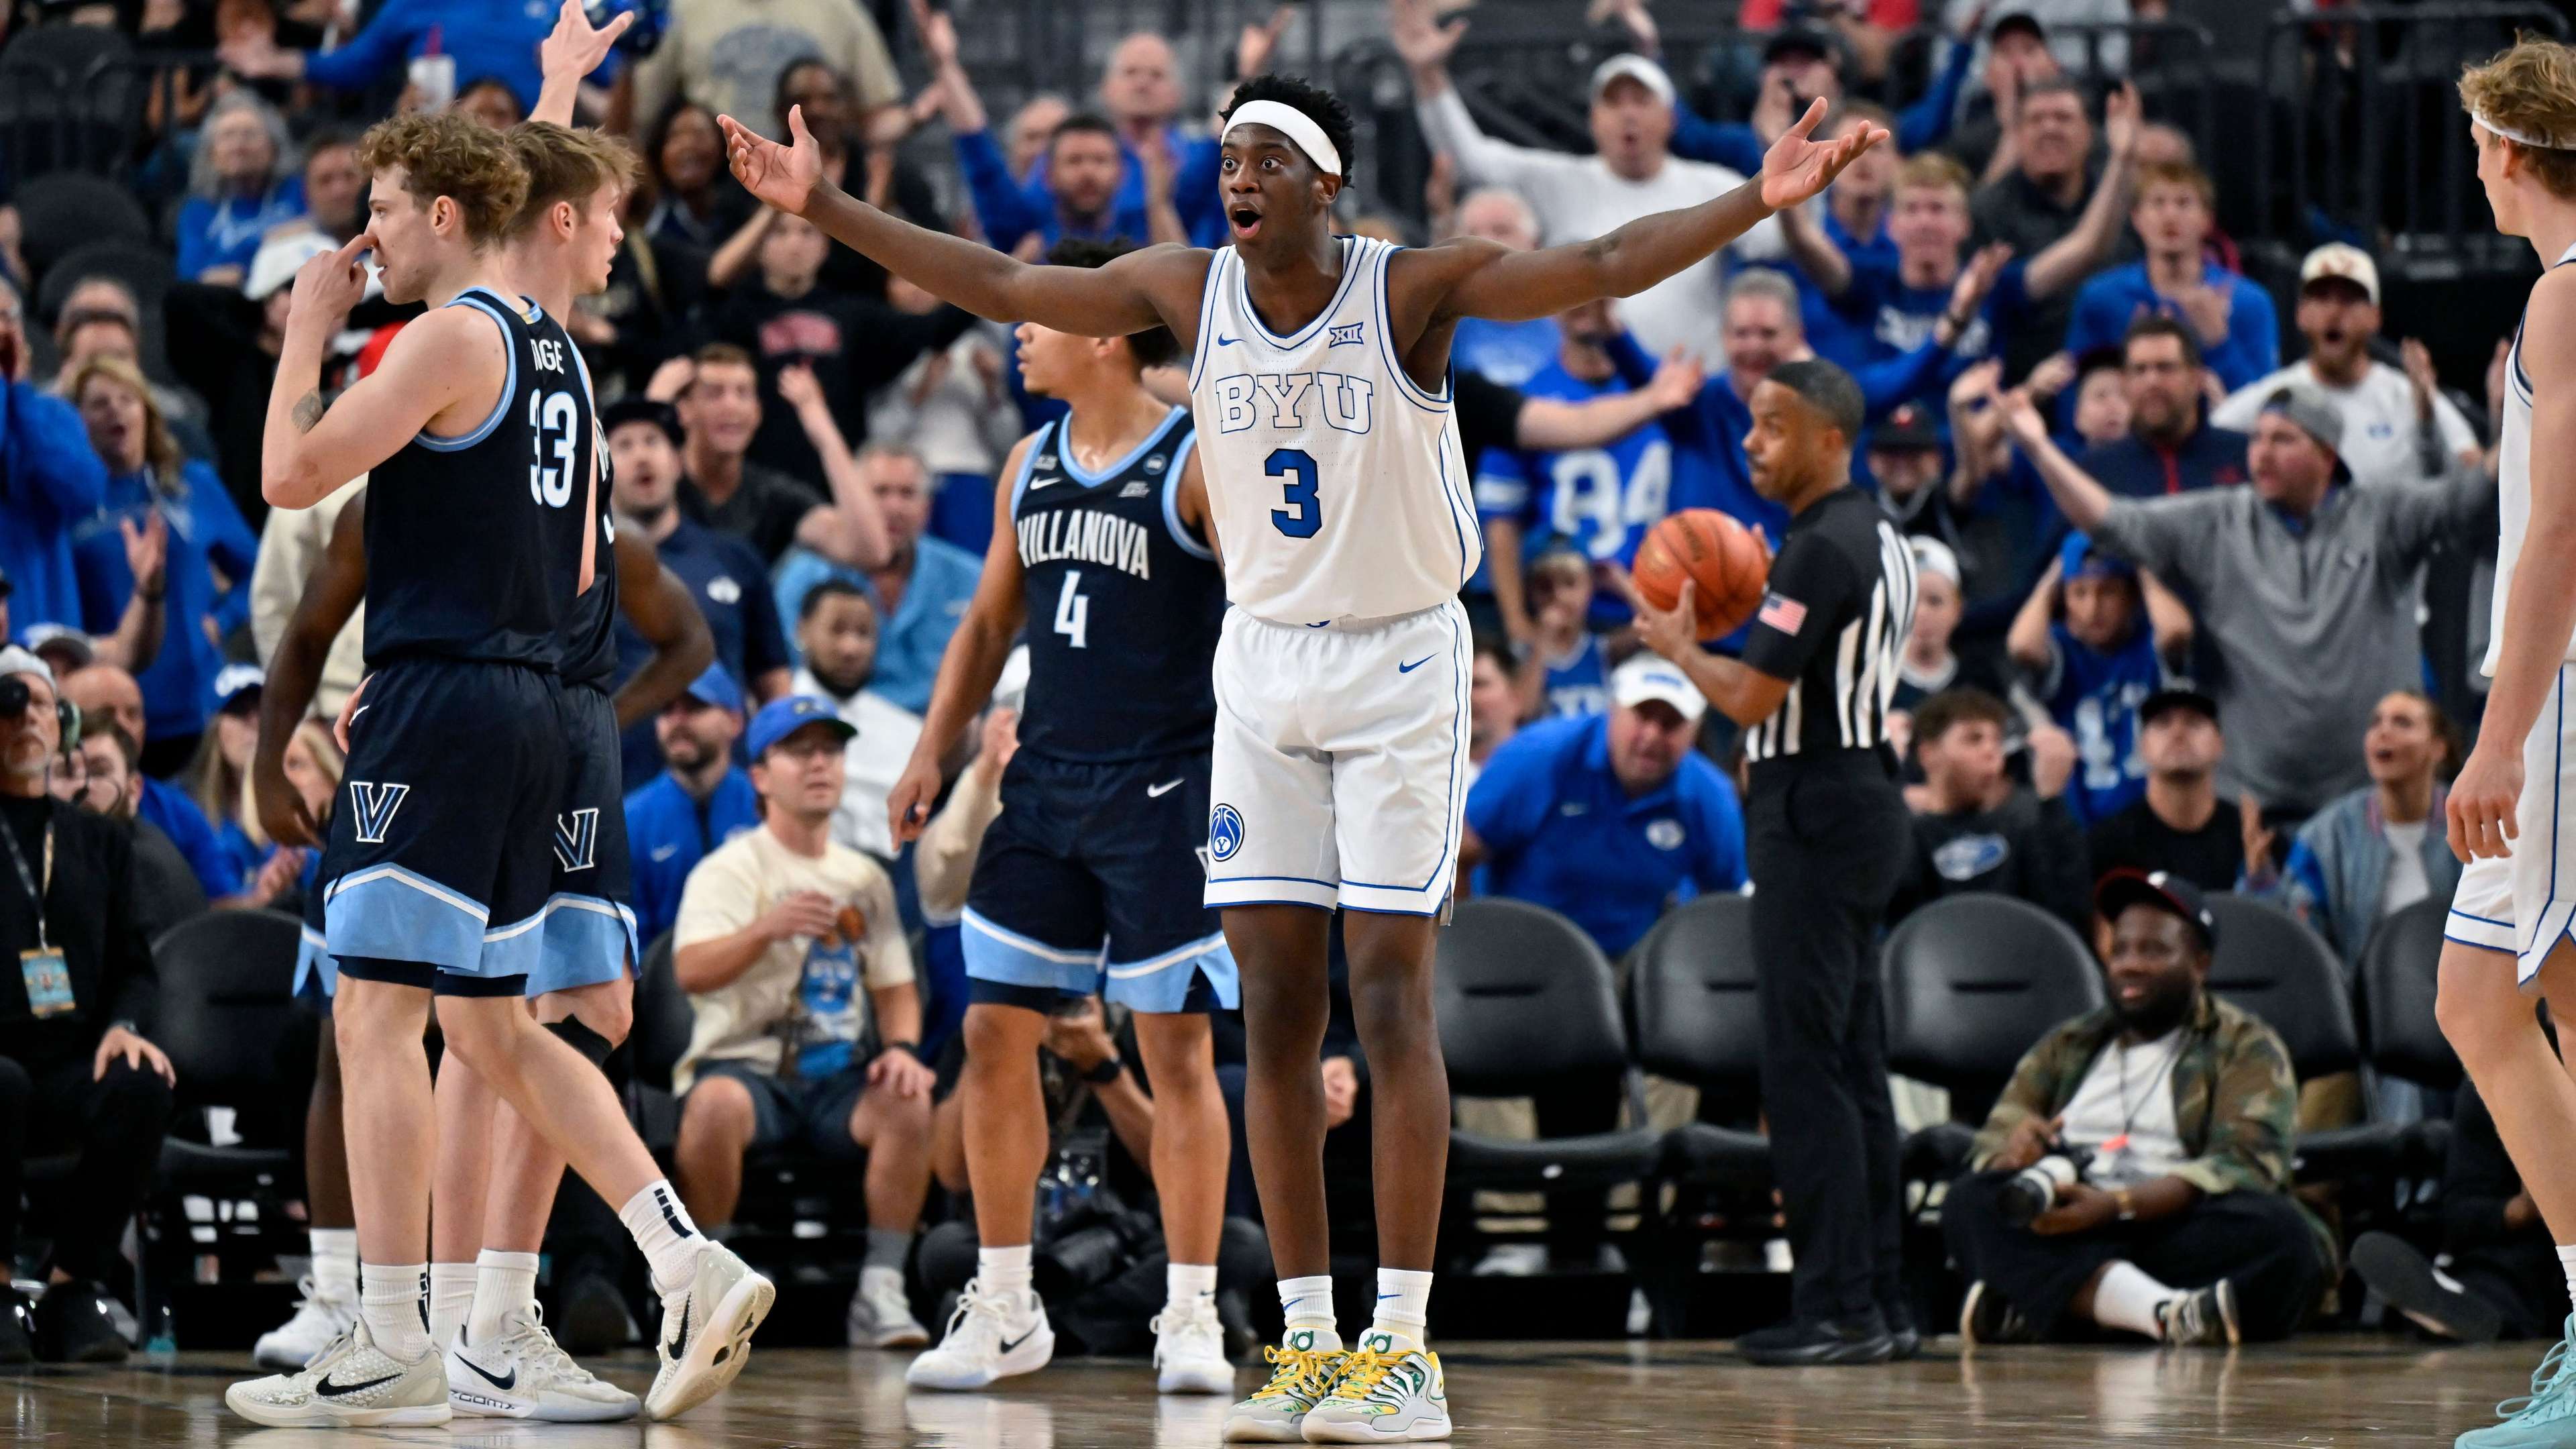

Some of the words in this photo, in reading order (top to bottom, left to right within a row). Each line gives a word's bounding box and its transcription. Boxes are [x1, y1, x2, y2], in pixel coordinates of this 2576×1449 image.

[1216, 372, 1373, 434] BYU
[1265, 448, 1322, 539] 3
[1017, 508, 1149, 580] VILLANOVA
[1053, 570, 1089, 648] 4
[350, 781, 410, 843] V
[1217, 839, 1228, 852] Y
